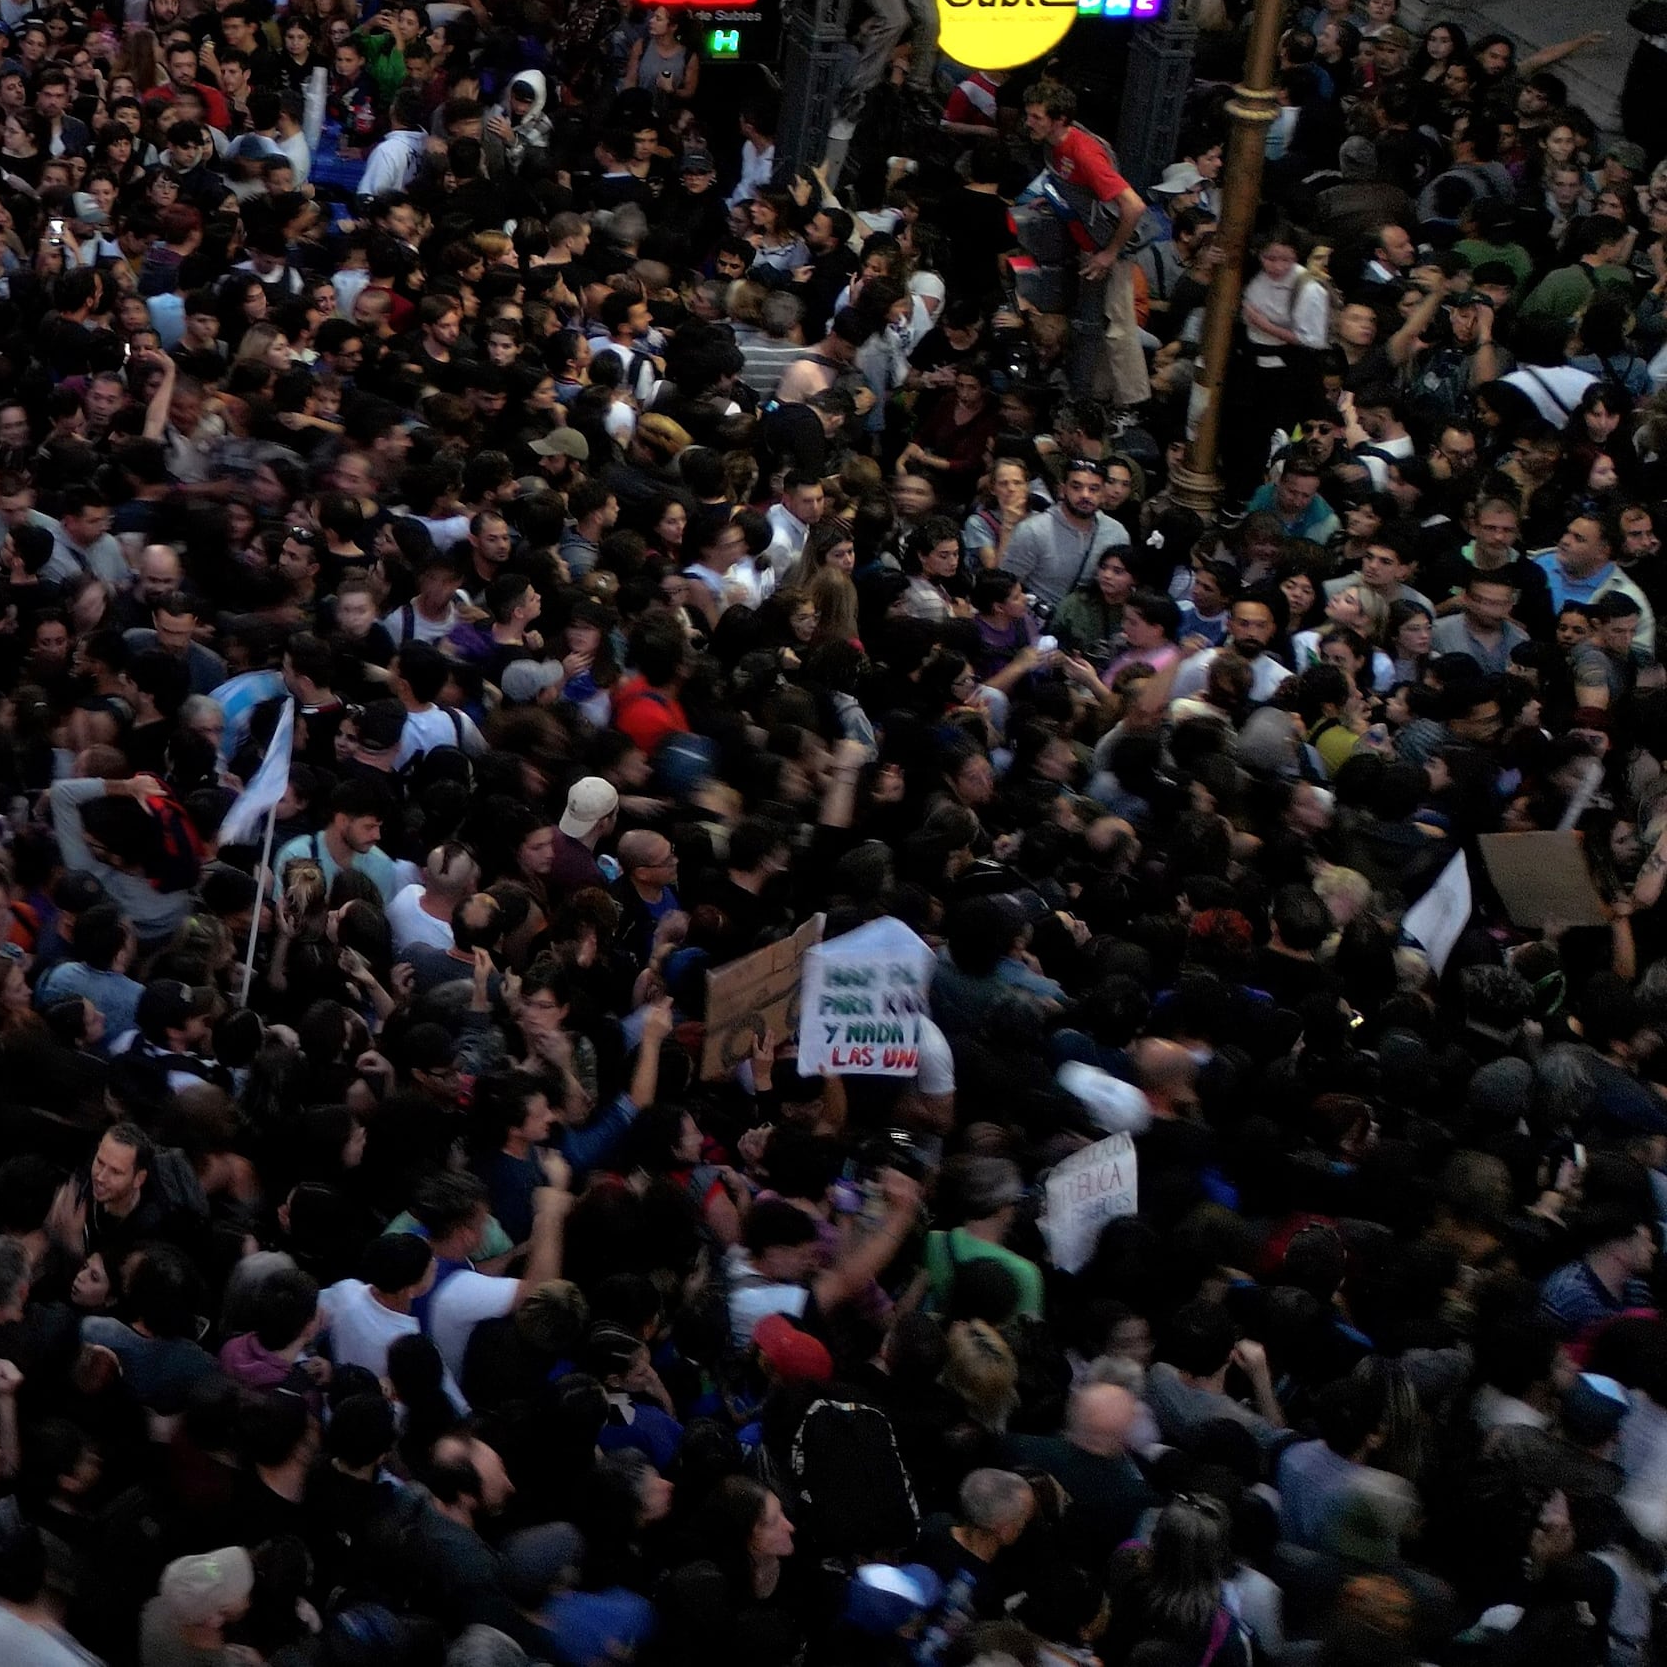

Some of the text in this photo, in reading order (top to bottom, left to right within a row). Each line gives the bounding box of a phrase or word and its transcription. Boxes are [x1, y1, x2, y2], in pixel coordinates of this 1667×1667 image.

[823, 1021, 905, 1044] Y NADA
[831, 1045, 875, 1068] LAS
